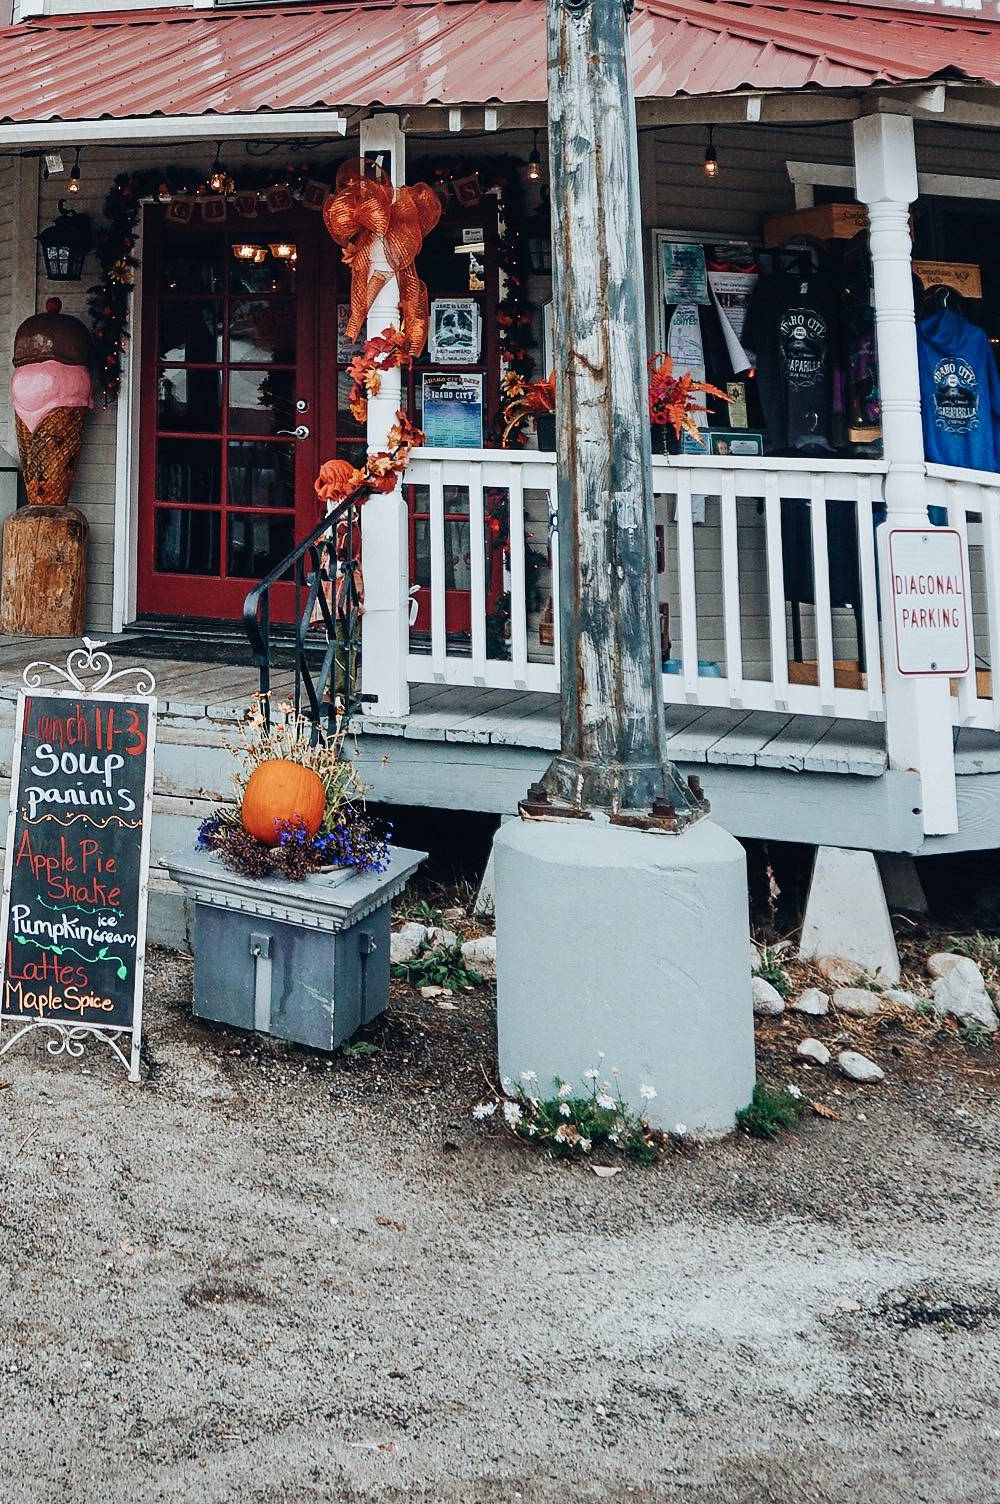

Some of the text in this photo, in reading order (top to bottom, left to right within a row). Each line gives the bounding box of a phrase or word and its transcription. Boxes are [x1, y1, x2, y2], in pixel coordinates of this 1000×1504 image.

[431, 390, 474, 400] IDAHO CITY
[895, 575, 962, 595] DIAGONAL
[902, 608, 960, 628] PARKING
[23, 697, 147, 756] Lunch 11-3
[30, 743, 125, 788] Soup
[24, 781, 136, 820] paninis
[16, 828, 117, 882] Apple Pie
[48, 875, 121, 907] Shake
[11, 904, 137, 947] Pumpkin ice cream
[7, 941, 89, 988] Lattes
[4, 980, 115, 1018] Maple Spice
